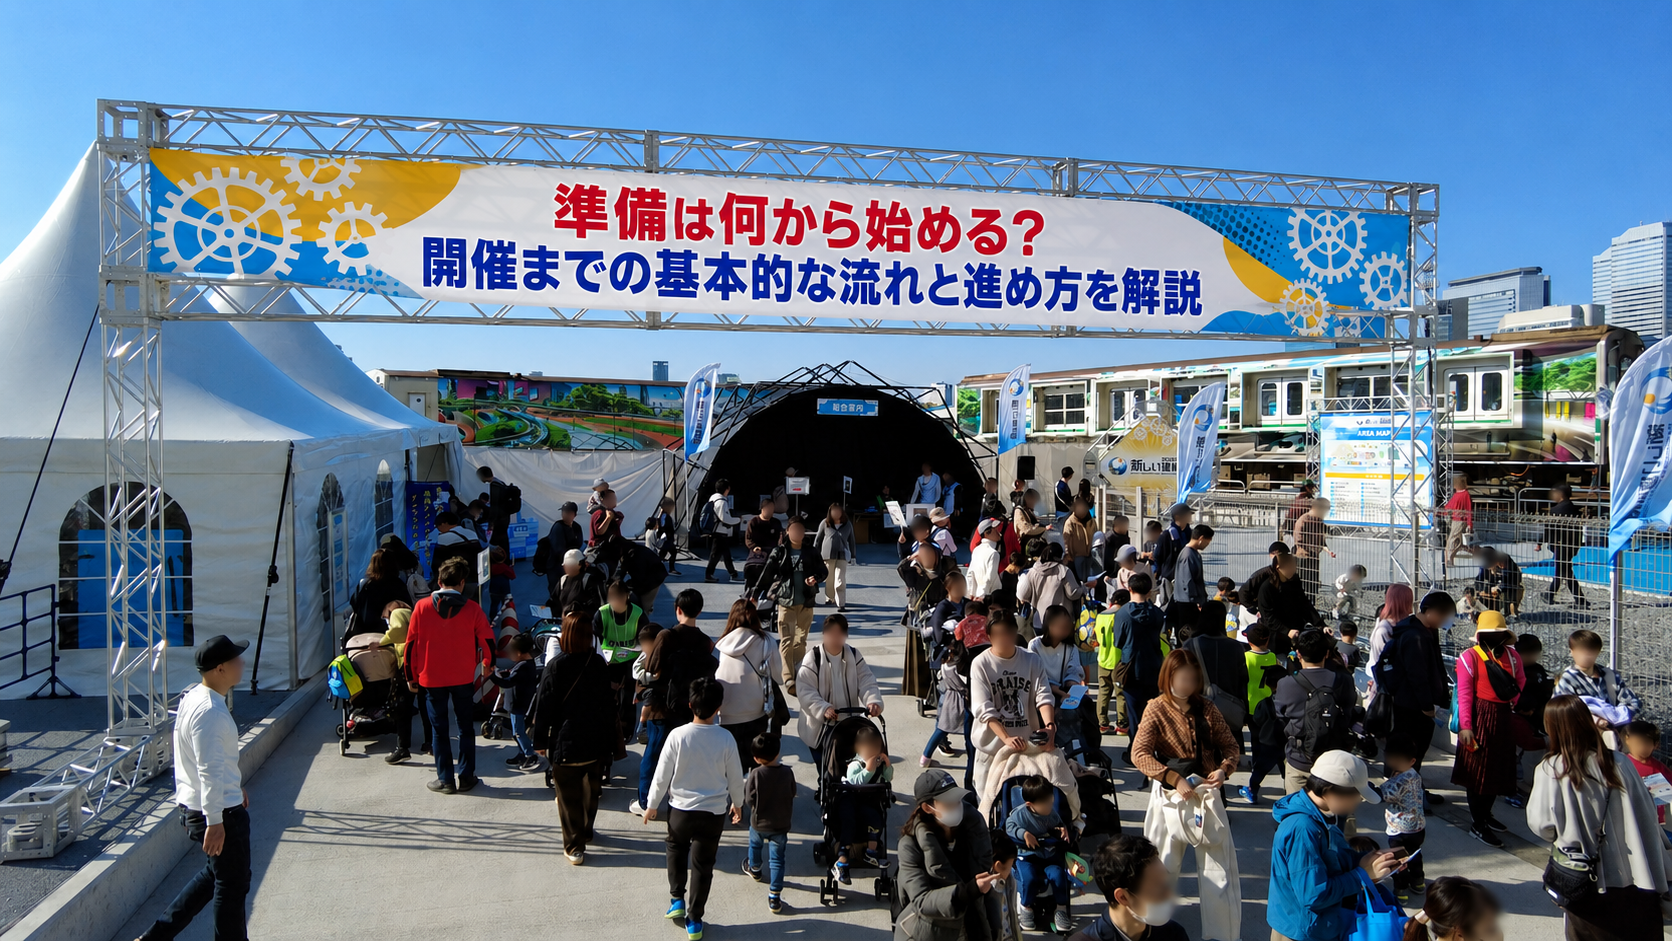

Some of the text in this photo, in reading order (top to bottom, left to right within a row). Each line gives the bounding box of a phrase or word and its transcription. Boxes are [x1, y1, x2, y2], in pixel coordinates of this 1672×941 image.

[554, 183, 1045, 256] 準備は何から始める？
[423, 236, 1203, 316] 開催までの基本的な流れと進め方を解説
